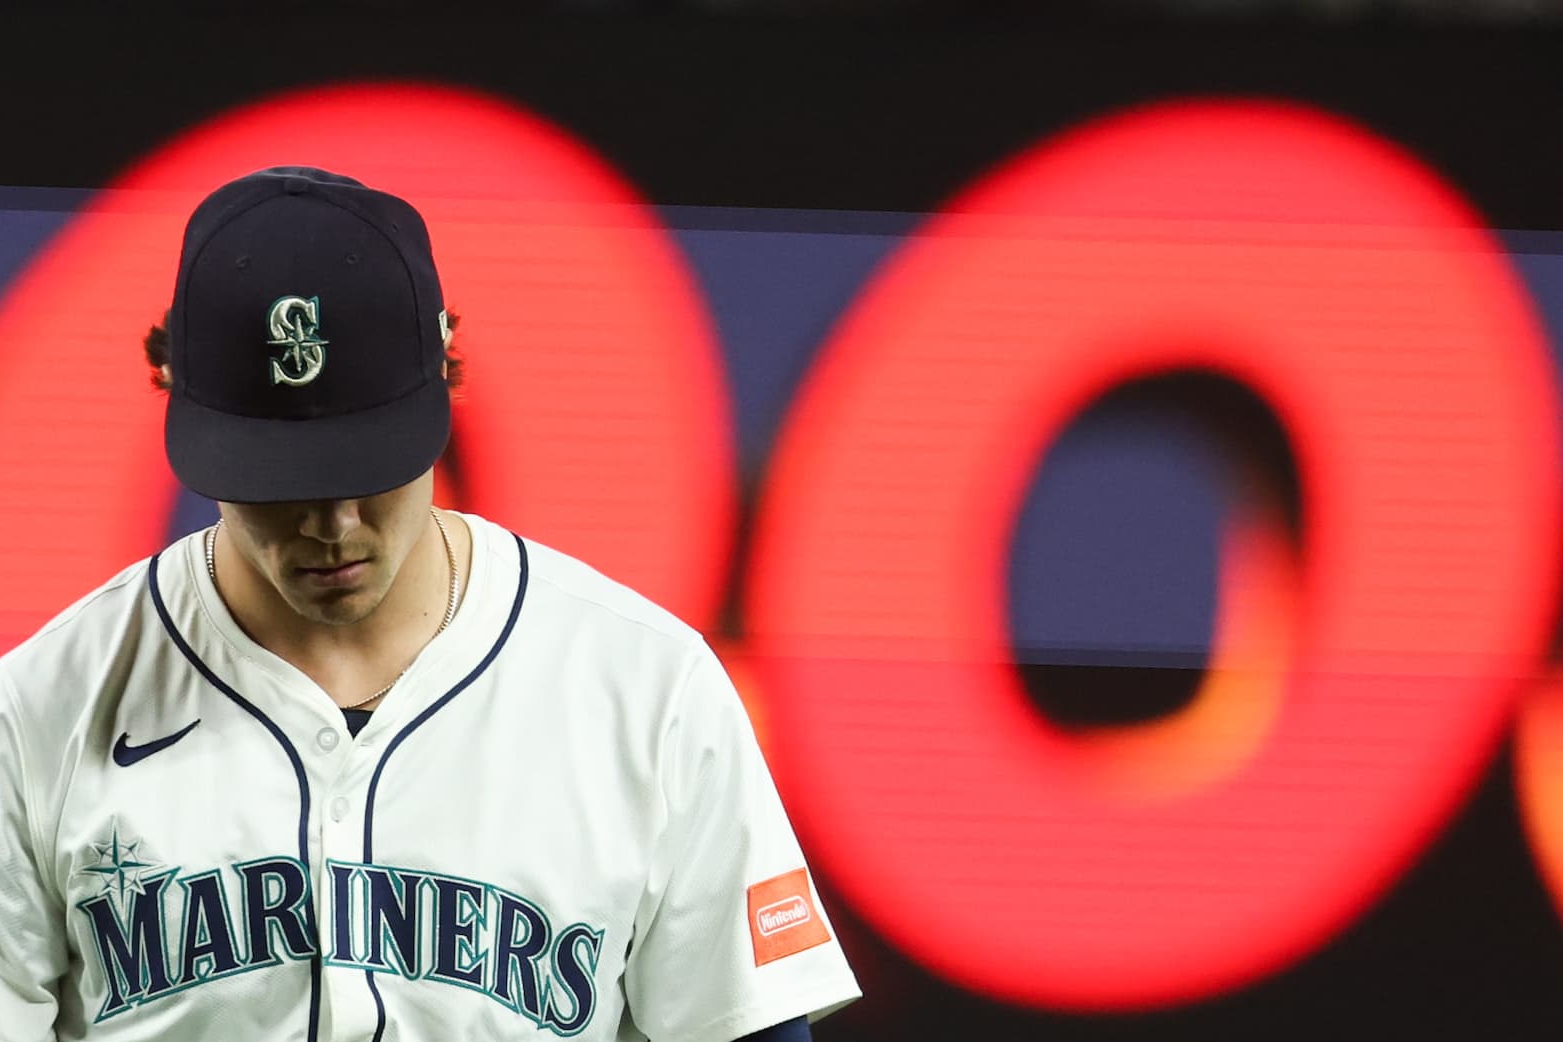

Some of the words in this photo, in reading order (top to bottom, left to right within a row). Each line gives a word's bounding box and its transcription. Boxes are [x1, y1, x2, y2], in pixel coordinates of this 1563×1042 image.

[268, 295, 327, 387] S
[76, 855, 605, 1037] MARINERS
[759, 903, 807, 931] Nintendo
